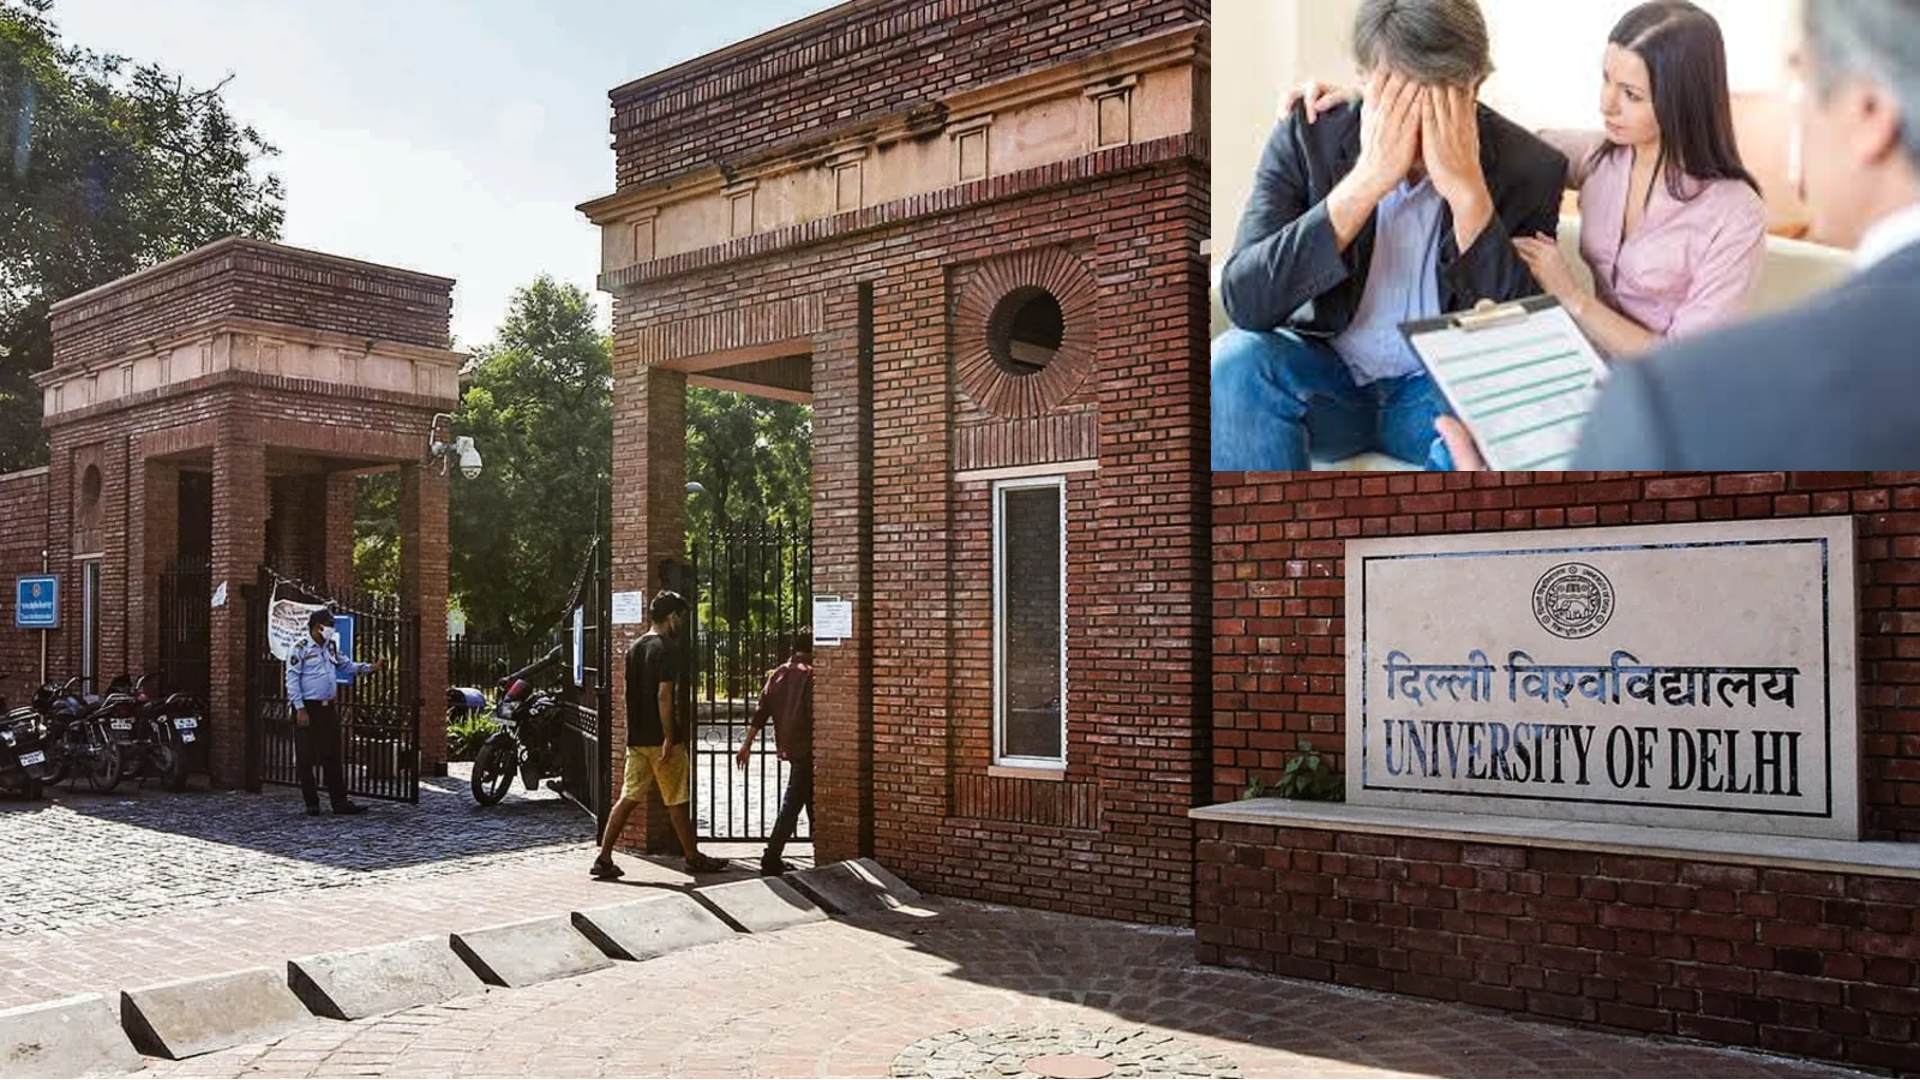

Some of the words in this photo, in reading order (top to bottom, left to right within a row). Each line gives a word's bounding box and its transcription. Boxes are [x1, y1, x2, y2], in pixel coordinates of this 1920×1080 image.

[1382, 649, 1496, 706] दिल्ली
[1502, 650, 1800, 709] विश्वविद्यालय
[1384, 719, 1596, 785] UNIVERSITY
[1606, 725, 1658, 789] OF
[1668, 727, 1803, 797] DELHI
